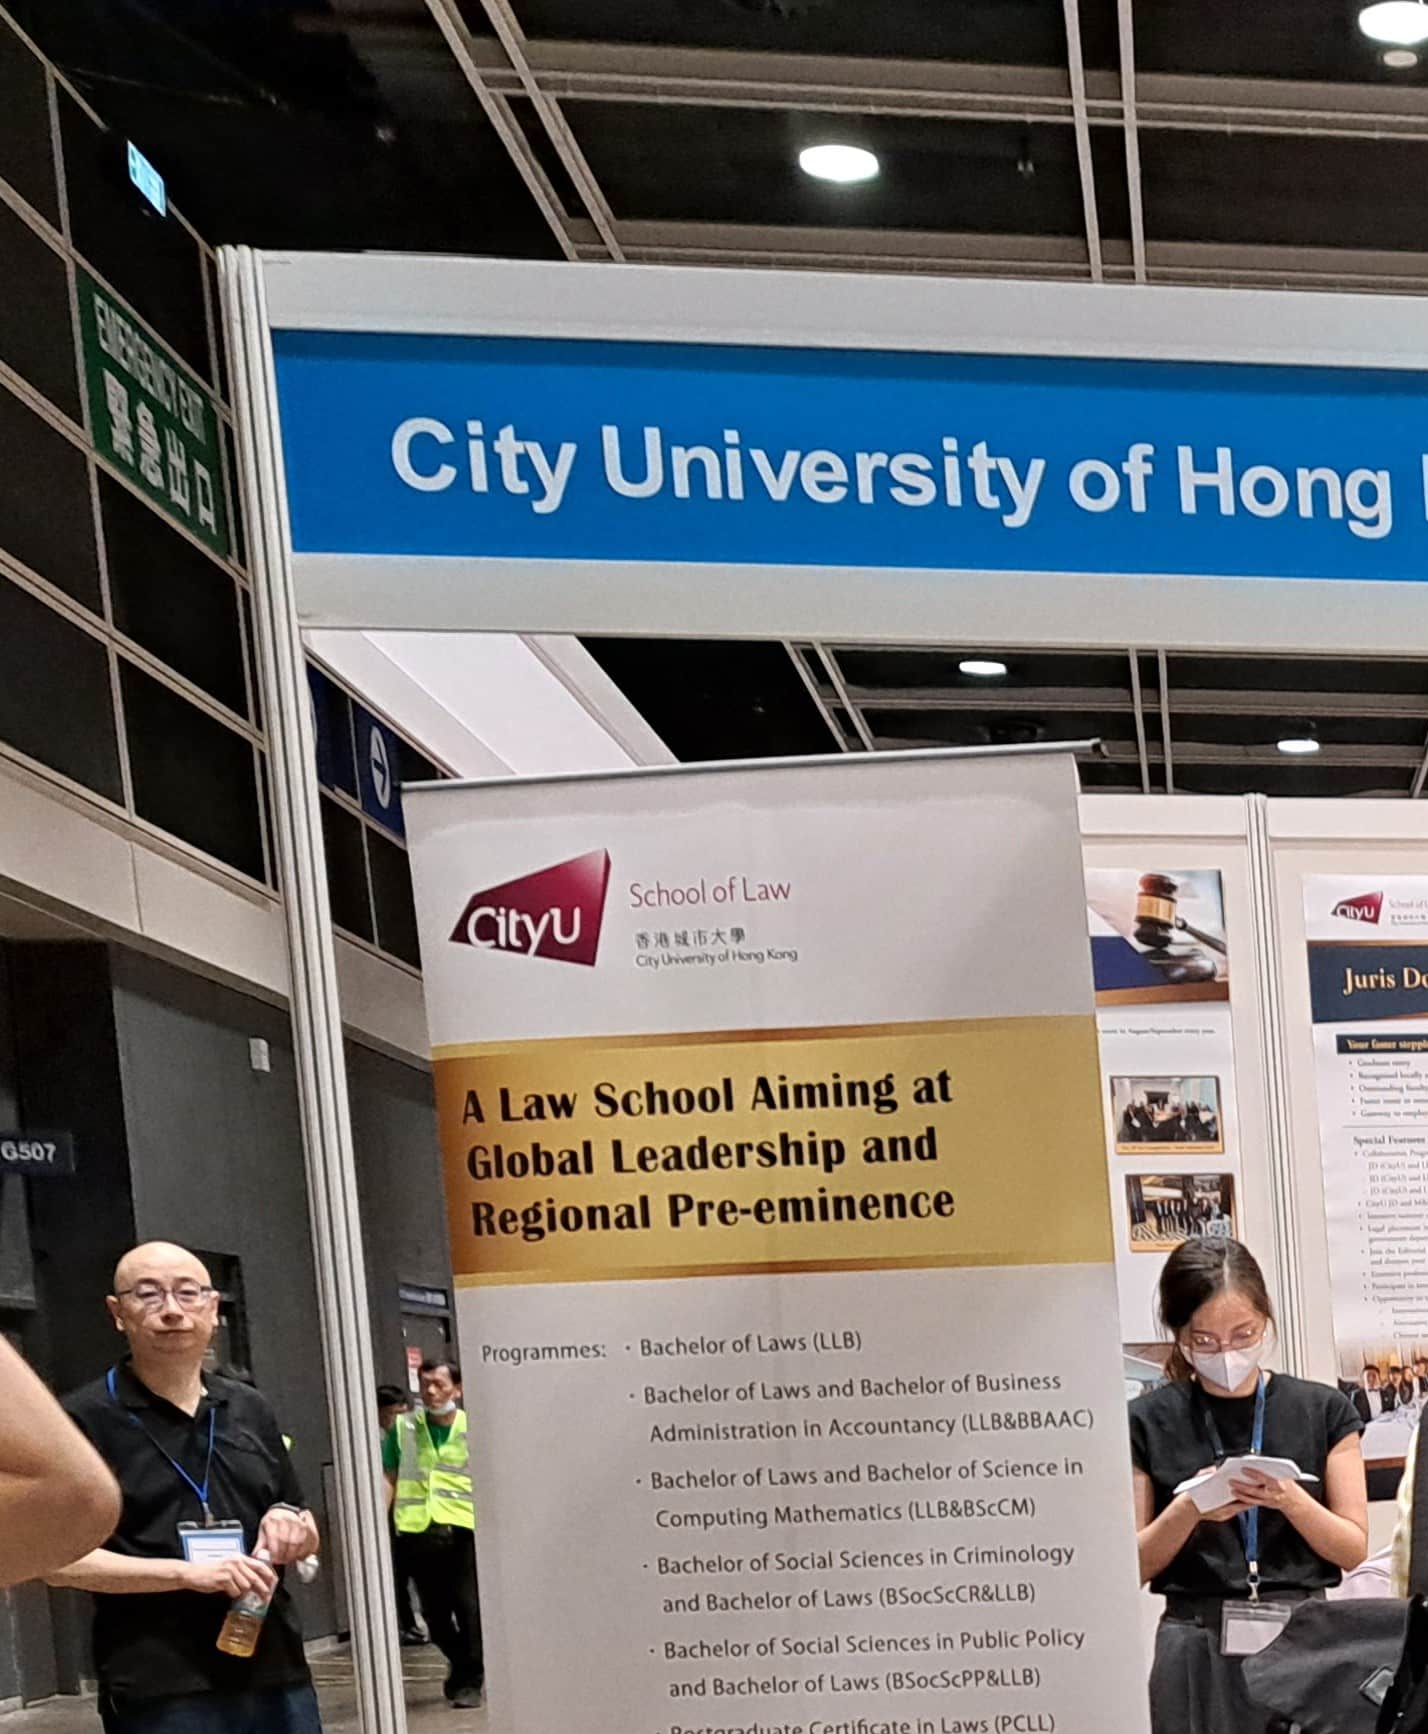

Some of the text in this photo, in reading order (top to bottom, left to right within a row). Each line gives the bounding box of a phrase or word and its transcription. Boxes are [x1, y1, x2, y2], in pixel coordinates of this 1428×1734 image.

[392, 418, 576, 513] City
[602, 425, 1045, 527] University
[1070, 444, 1153, 512] of
[1178, 446, 1392, 538] Hong
[630, 876, 790, 907] School of Law
[467, 907, 581, 958] CityU
[1343, 968, 1395, 995] Juris
[463, 1070, 952, 1125] A Law School Aiming at
[0, 1141, 57, 1164] G507
[467, 1126, 937, 1180] Global Leadership and
[470, 1187, 954, 1242] Regional Pre-eminence
[482, 1345, 606, 1365] Programmes:
[641, 1331, 861, 1356] Bachelor of Laws (LLB)
[645, 1374, 1061, 1404] Bachelor of Laws and Bachelor of Business
[651, 1410, 1093, 1442] Administration in Accountancy (LLB&BBAAC)
[651, 1458, 1083, 1489] Bachelor of Laws and Bachelor of Science in
[656, 1498, 1035, 1530] Computing Mathematics (LLB&BScCM)
[658, 1544, 1074, 1574] Bachelor of Social Sciences in Criminology
[664, 1584, 1035, 1612] and Bachelor of Laws (BSocScCR&LLB)
[665, 1628, 1084, 1659] Bachelor of Social Sciences in Public Policy
[918, 1719, 934, 1734] in
[941, 1717, 988, 1734] Laws
[995, 1714, 1054, 1734] (PCLL)
